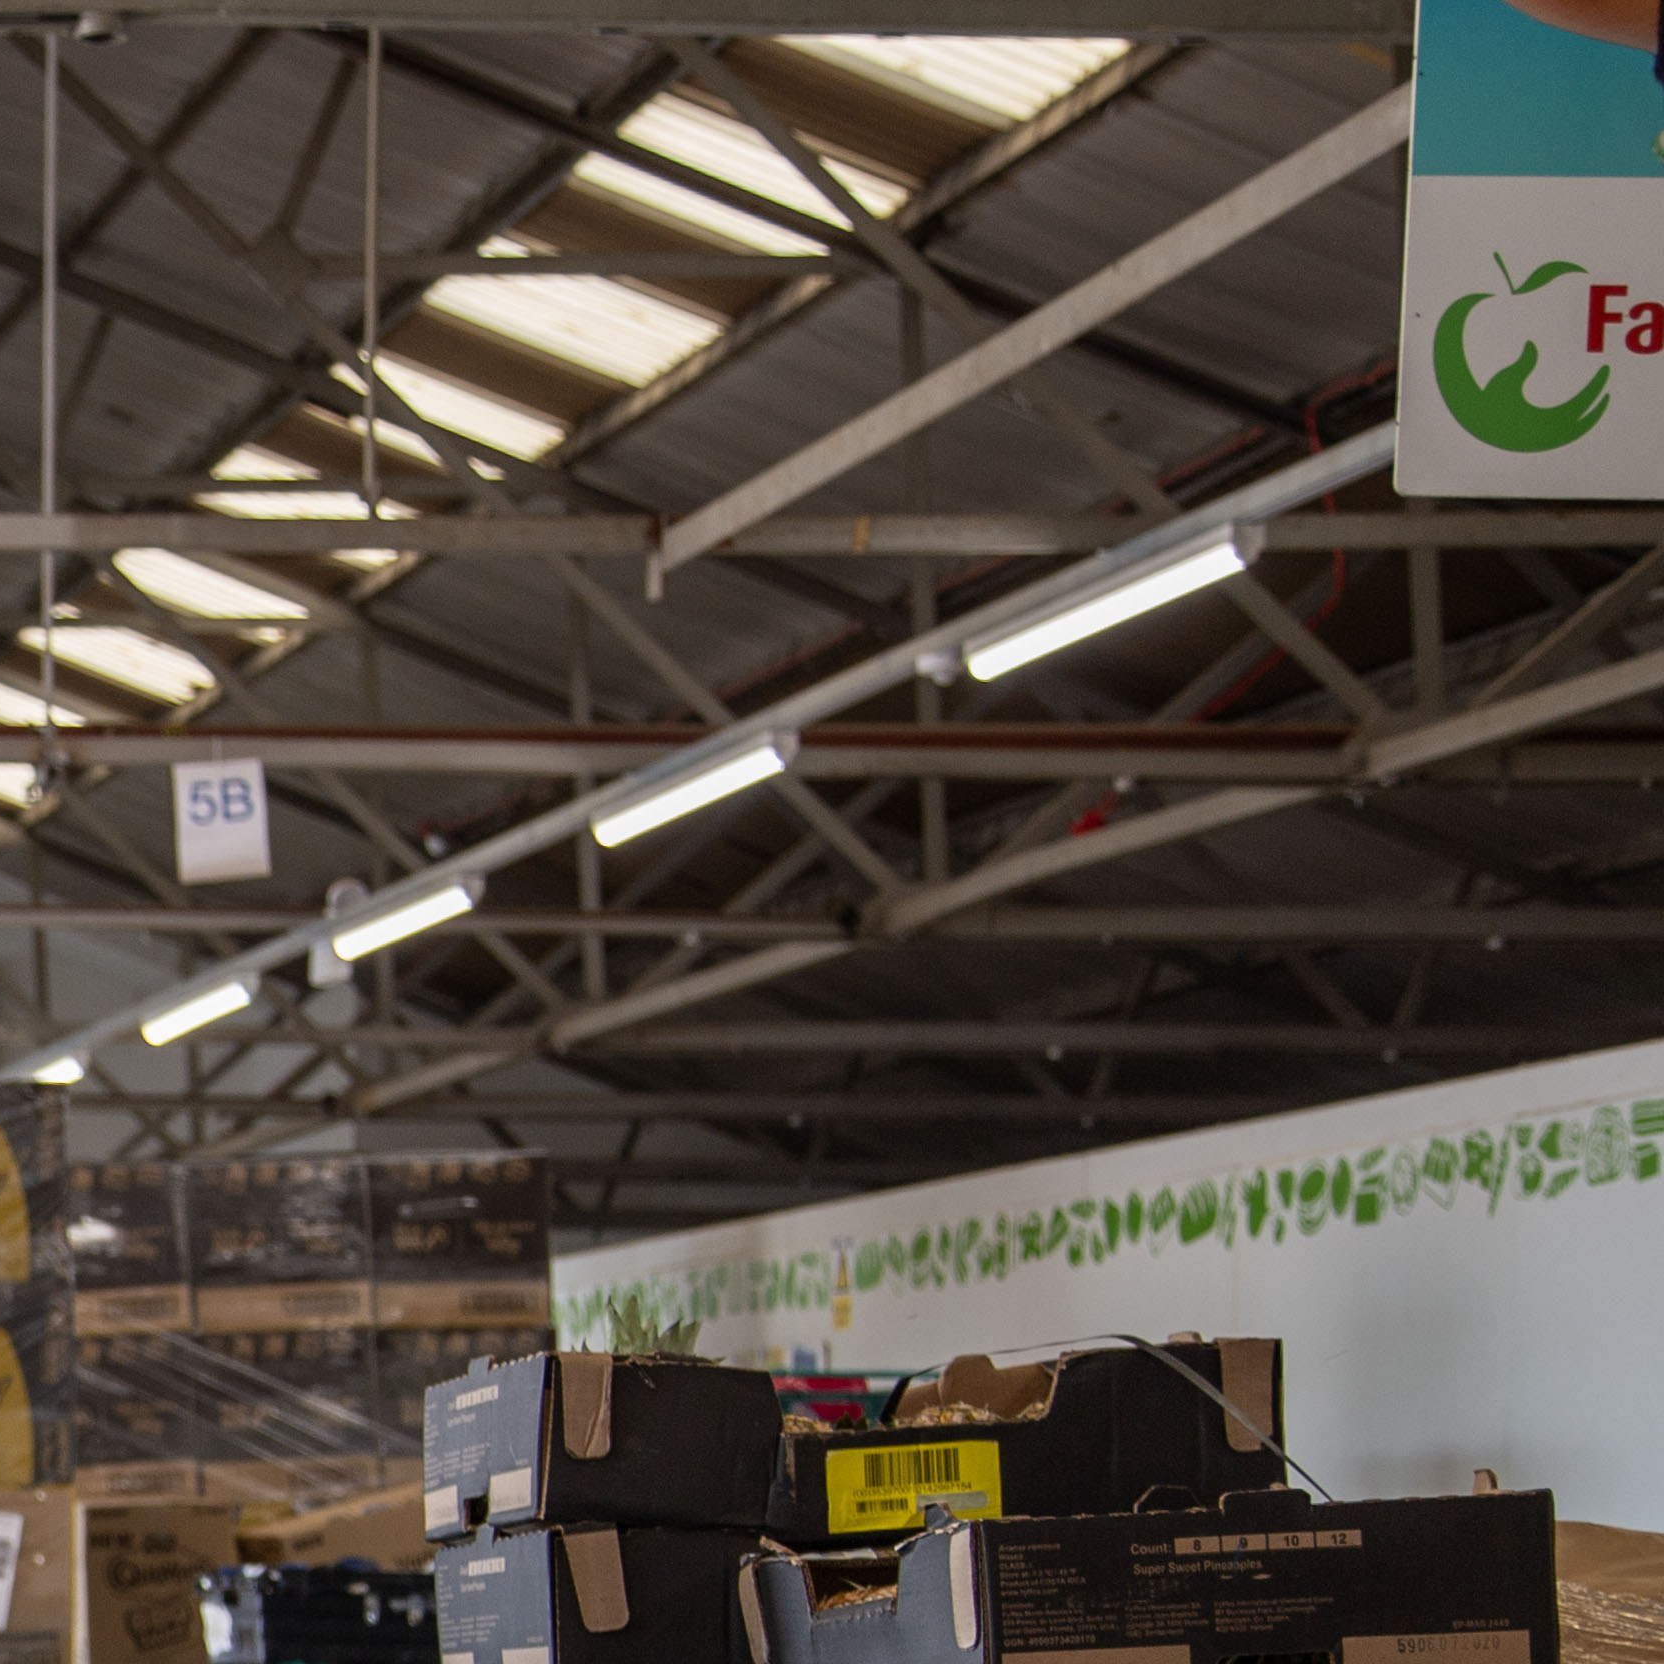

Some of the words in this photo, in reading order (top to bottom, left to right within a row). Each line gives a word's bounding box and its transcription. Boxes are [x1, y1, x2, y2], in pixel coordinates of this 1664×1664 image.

[188, 777, 256, 827] 5B
[1130, 1543, 1171, 1556] Count:
[1193, 1539, 1201, 1551] 8
[1240, 1538, 1248, 1549] 9
[1284, 1536, 1300, 1547] 10
[1331, 1533, 1347, 1545] 12
[1133, 1563, 1166, 1576] Super
[1169, 1561, 1202, 1573] Sweet
[1204, 1558, 1263, 1572] Pineapples
